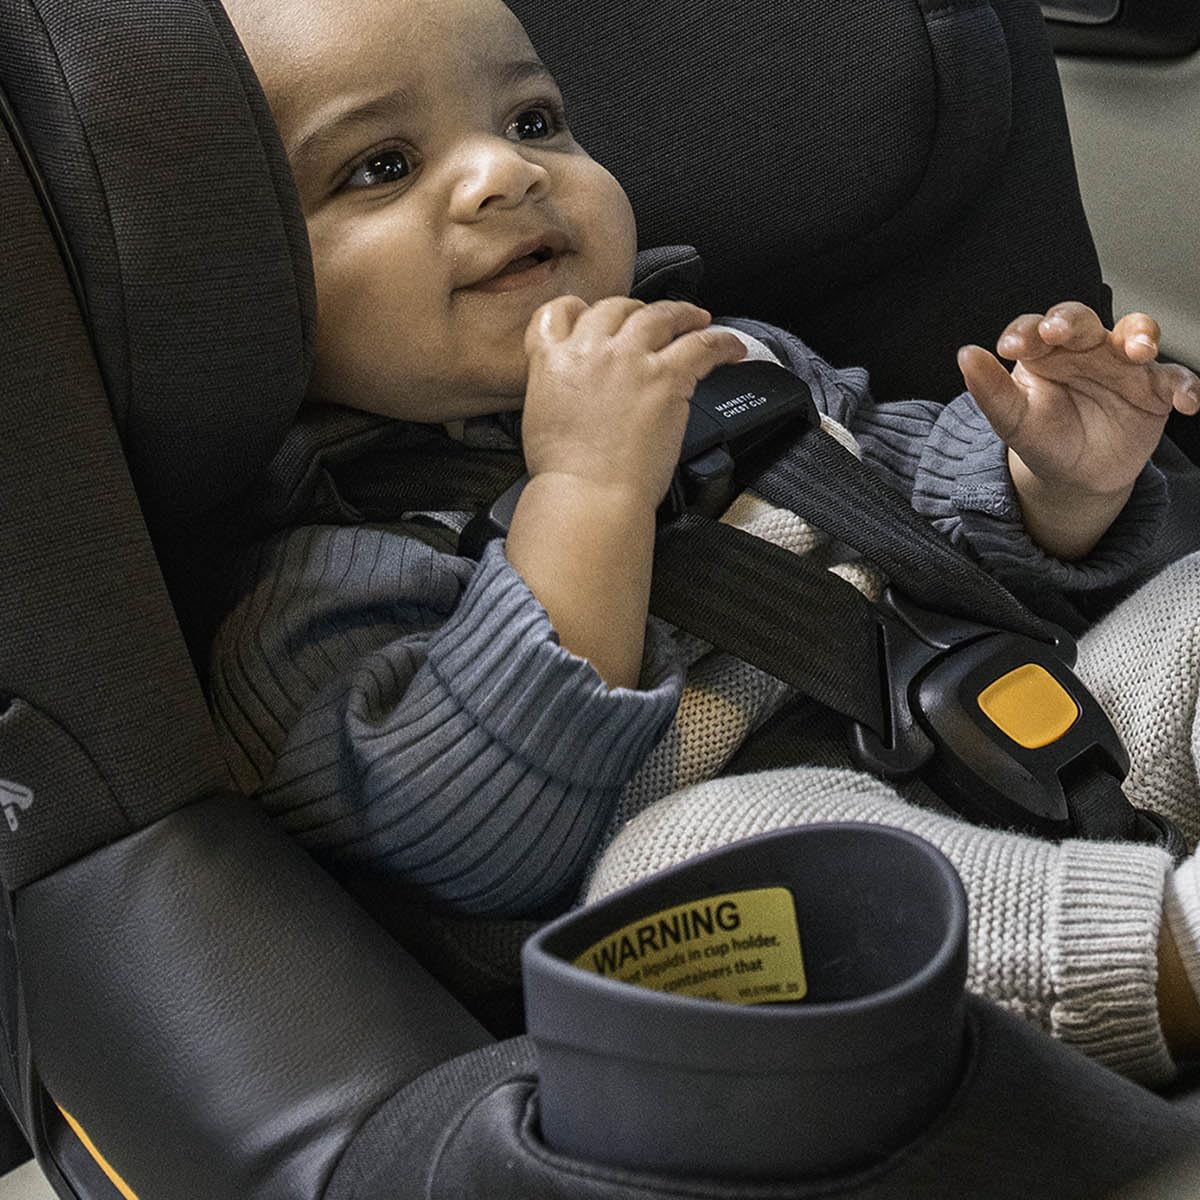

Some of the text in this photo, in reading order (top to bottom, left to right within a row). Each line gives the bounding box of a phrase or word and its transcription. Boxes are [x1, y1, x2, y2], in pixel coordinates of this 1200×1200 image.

[714, 392, 755, 412] MAGNETIC
[723, 396, 767, 418] CHEST CLIP
[592, 902, 741, 974] WARNING
[688, 949, 702, 962] in
[703, 943, 730, 959] cup
[731, 933, 781, 952] holder.
[734, 958, 763, 975] that
